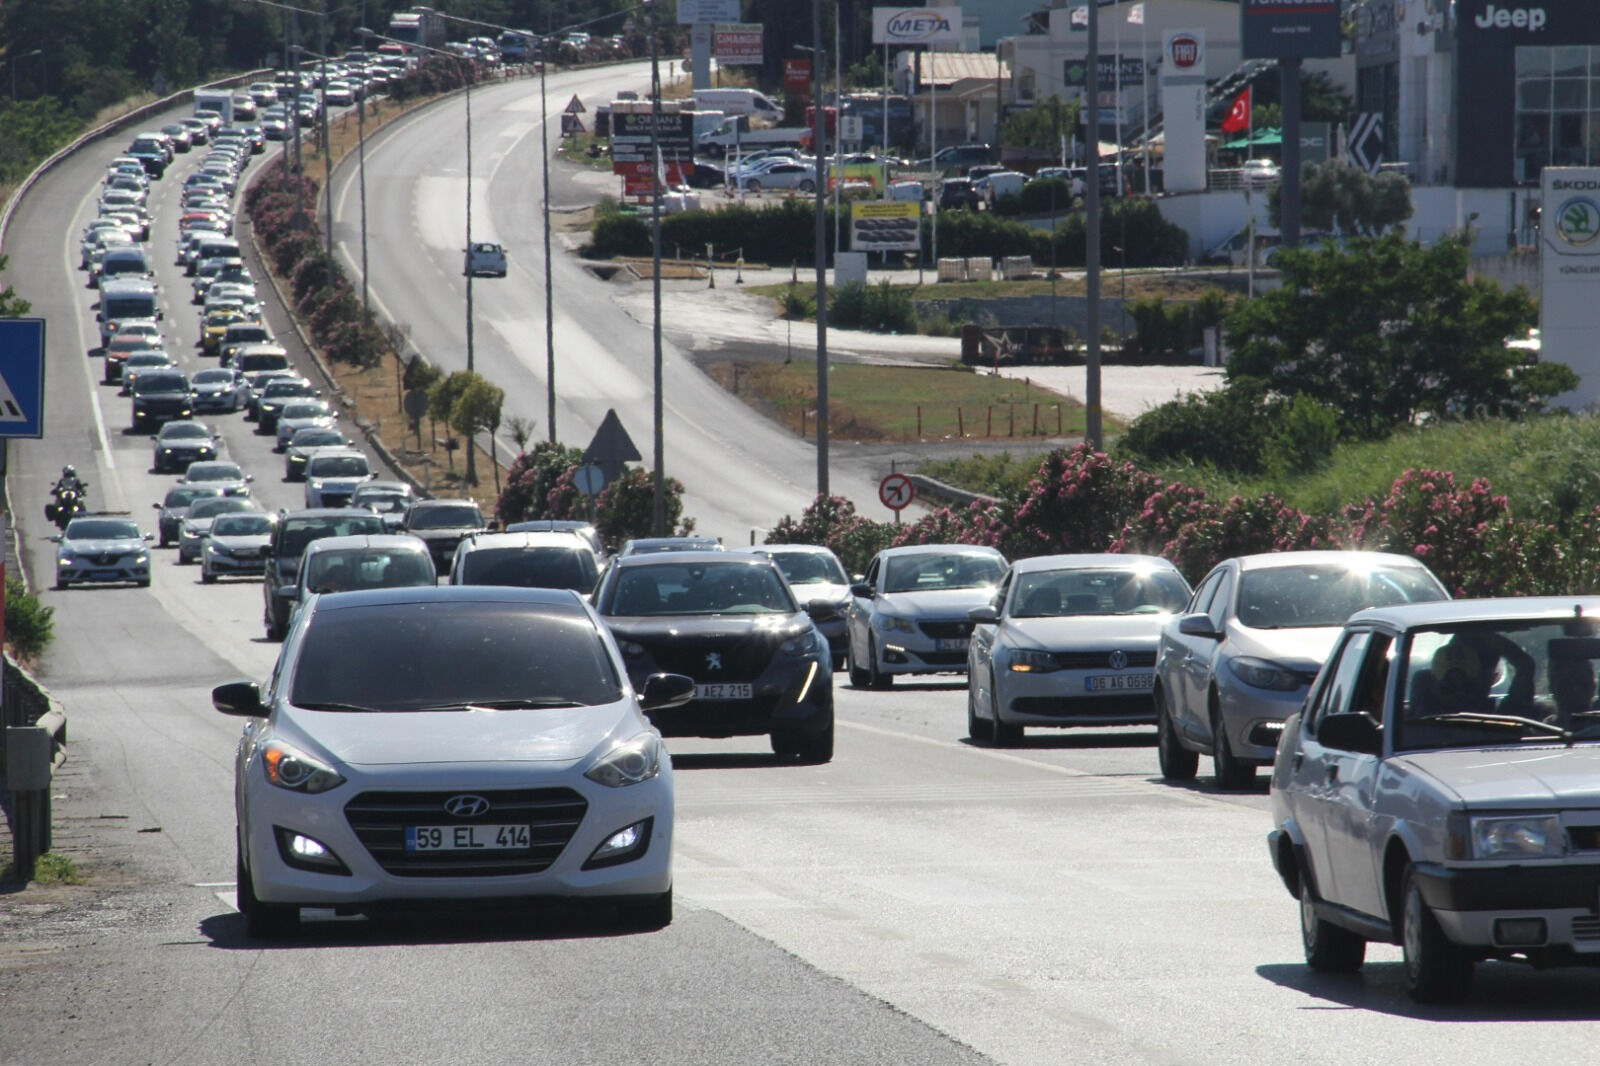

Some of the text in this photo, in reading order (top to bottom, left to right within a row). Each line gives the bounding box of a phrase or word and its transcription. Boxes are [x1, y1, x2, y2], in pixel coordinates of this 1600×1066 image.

[891, 18, 951, 32] META
[1474, 4, 1546, 32] Jeep
[1174, 44, 1195, 61] FIAT
[1086, 62, 1144, 74] RHAN'S
[704, 685, 724, 698] AEZ
[729, 684, 750, 698] 215
[416, 828, 442, 848] 59
[453, 826, 485, 848] EL
[495, 826, 529, 847] 414
